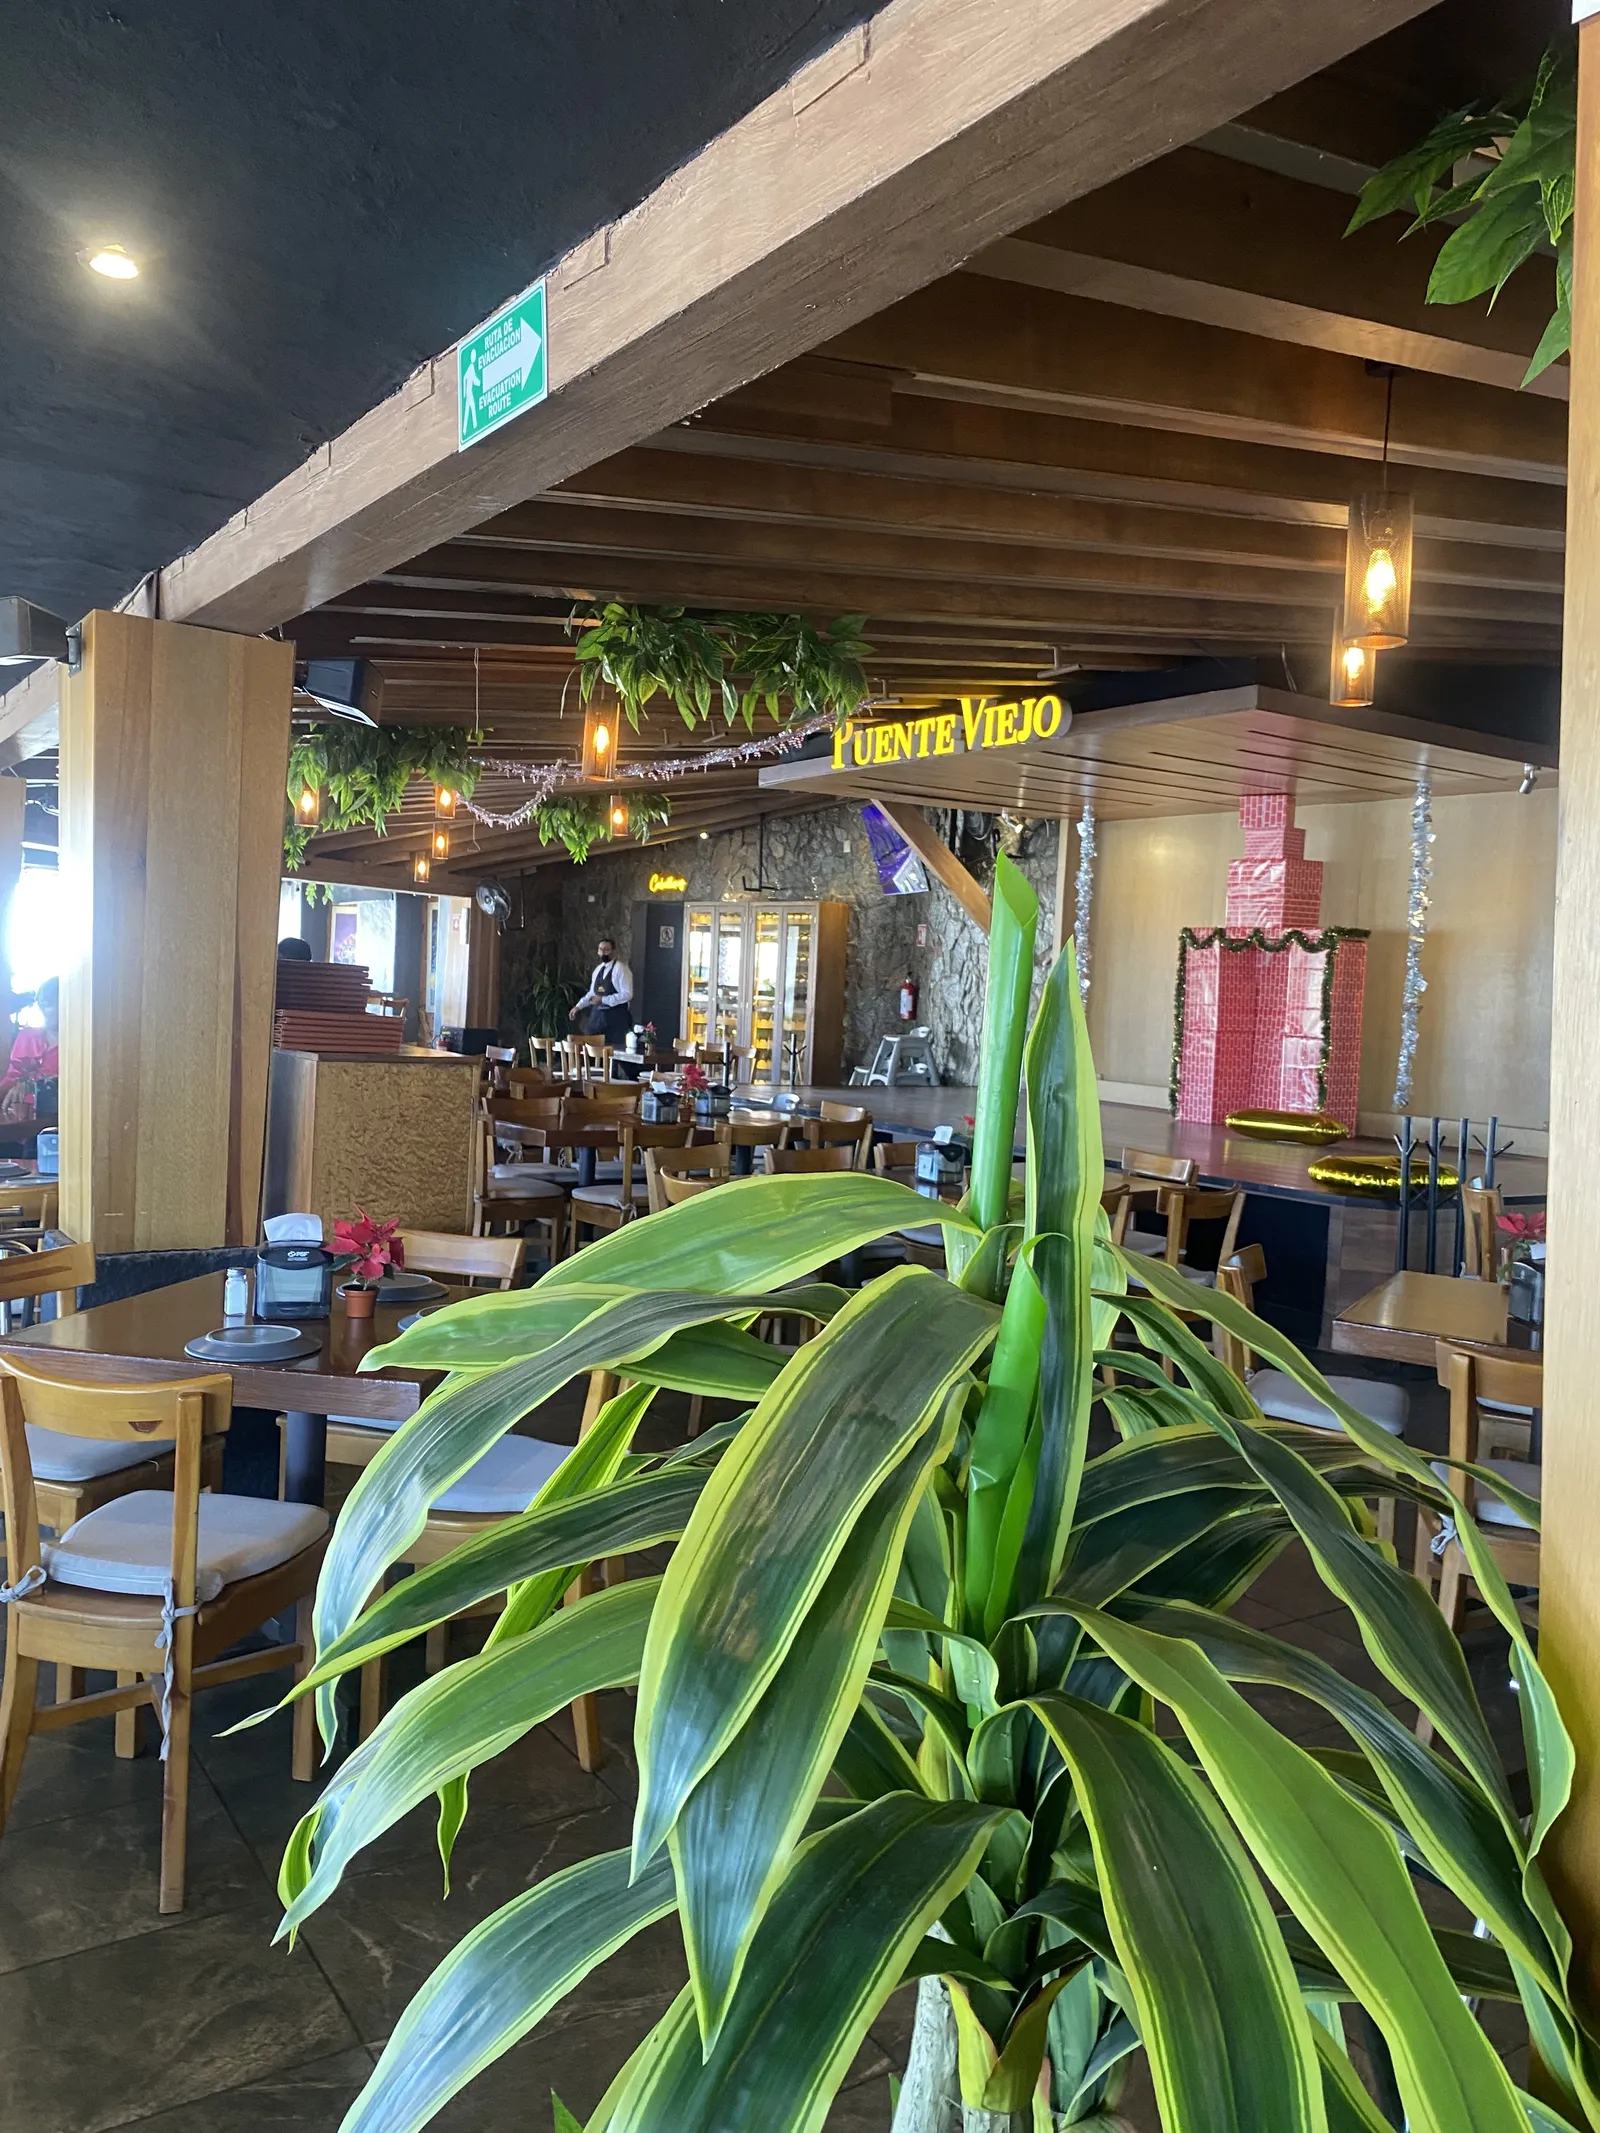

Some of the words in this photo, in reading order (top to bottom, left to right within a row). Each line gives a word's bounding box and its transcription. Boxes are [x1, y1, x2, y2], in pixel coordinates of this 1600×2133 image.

[478, 328, 522, 371] EVACUACION
[484, 326, 503, 349] RUTA
[503, 317, 514, 335] DE
[479, 370, 522, 411] EVACUATION
[488, 395, 512, 419] ROUTE
[831, 714, 957, 770] PUENTE
[957, 695, 1063, 751] VIEJO
